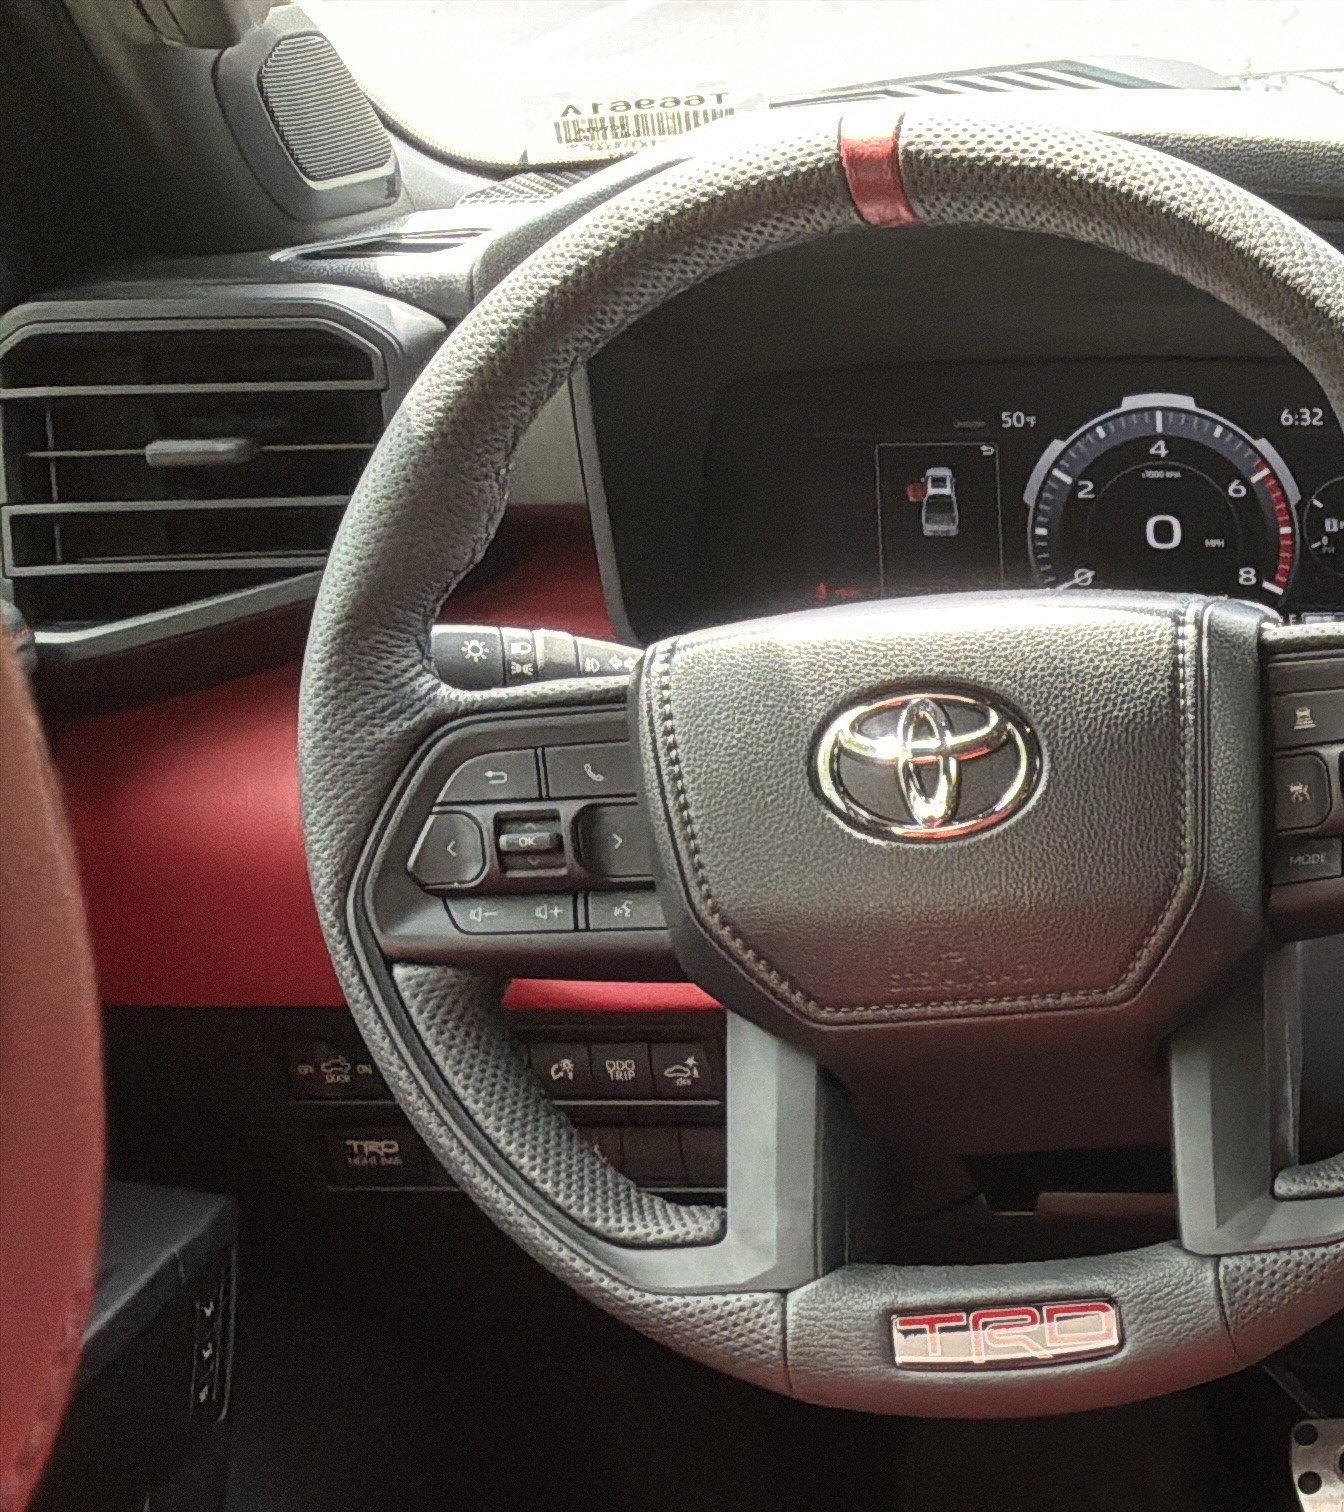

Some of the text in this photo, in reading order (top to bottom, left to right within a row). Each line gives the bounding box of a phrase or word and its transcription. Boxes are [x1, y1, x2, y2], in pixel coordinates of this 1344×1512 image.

[1280, 408, 1324, 427] 6:32
[1149, 440, 1169, 458] 4
[1077, 480, 1096, 499] 2
[1228, 480, 1248, 498] 6
[1145, 513, 1183, 550] 0
[1204, 538, 1226, 548] MPH
[1238, 567, 1258, 586] 8
[518, 836, 539, 848] OK
[1289, 852, 1327, 866] MODE
[605, 1059, 636, 1071] ODO
[607, 1069, 636, 1081] TRIP
[345, 1138, 400, 1157] TRD
[896, 1302, 1116, 1364] TRD
